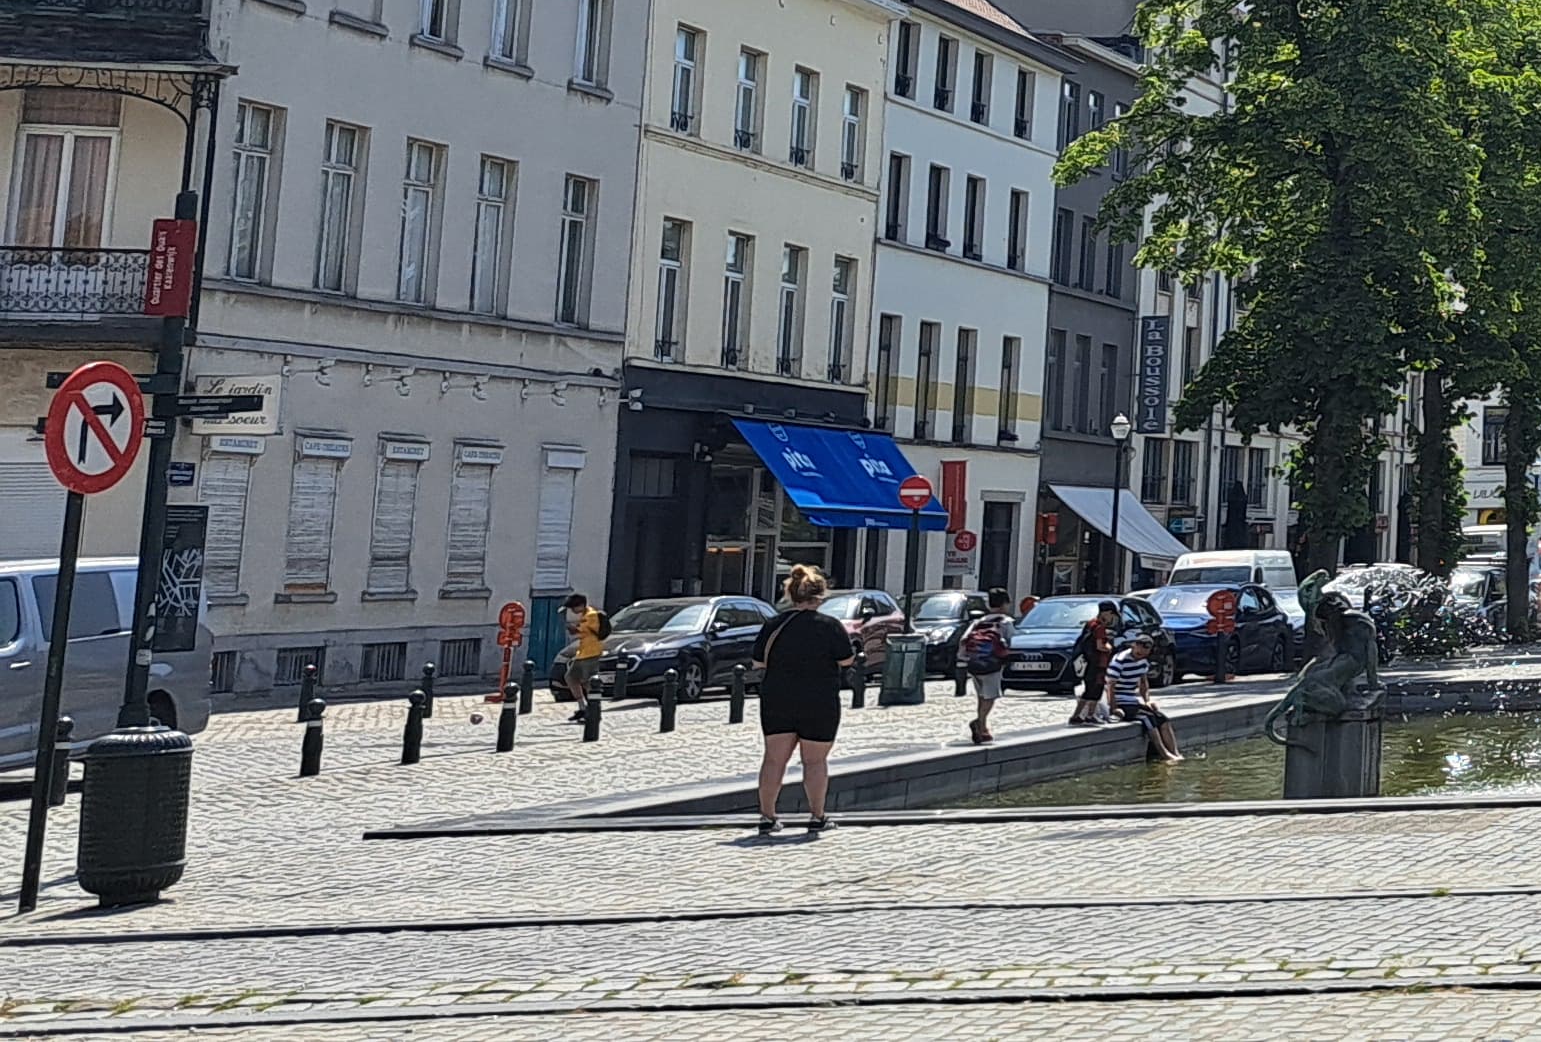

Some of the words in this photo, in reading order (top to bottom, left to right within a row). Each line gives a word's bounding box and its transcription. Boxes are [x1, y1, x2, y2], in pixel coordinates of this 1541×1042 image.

[203, 379, 225, 394] Le
[1143, 345, 1164, 431] Boussole
[226, 416, 268, 425] soeur
[782, 447, 816, 472] pita
[859, 453, 893, 478] pita
